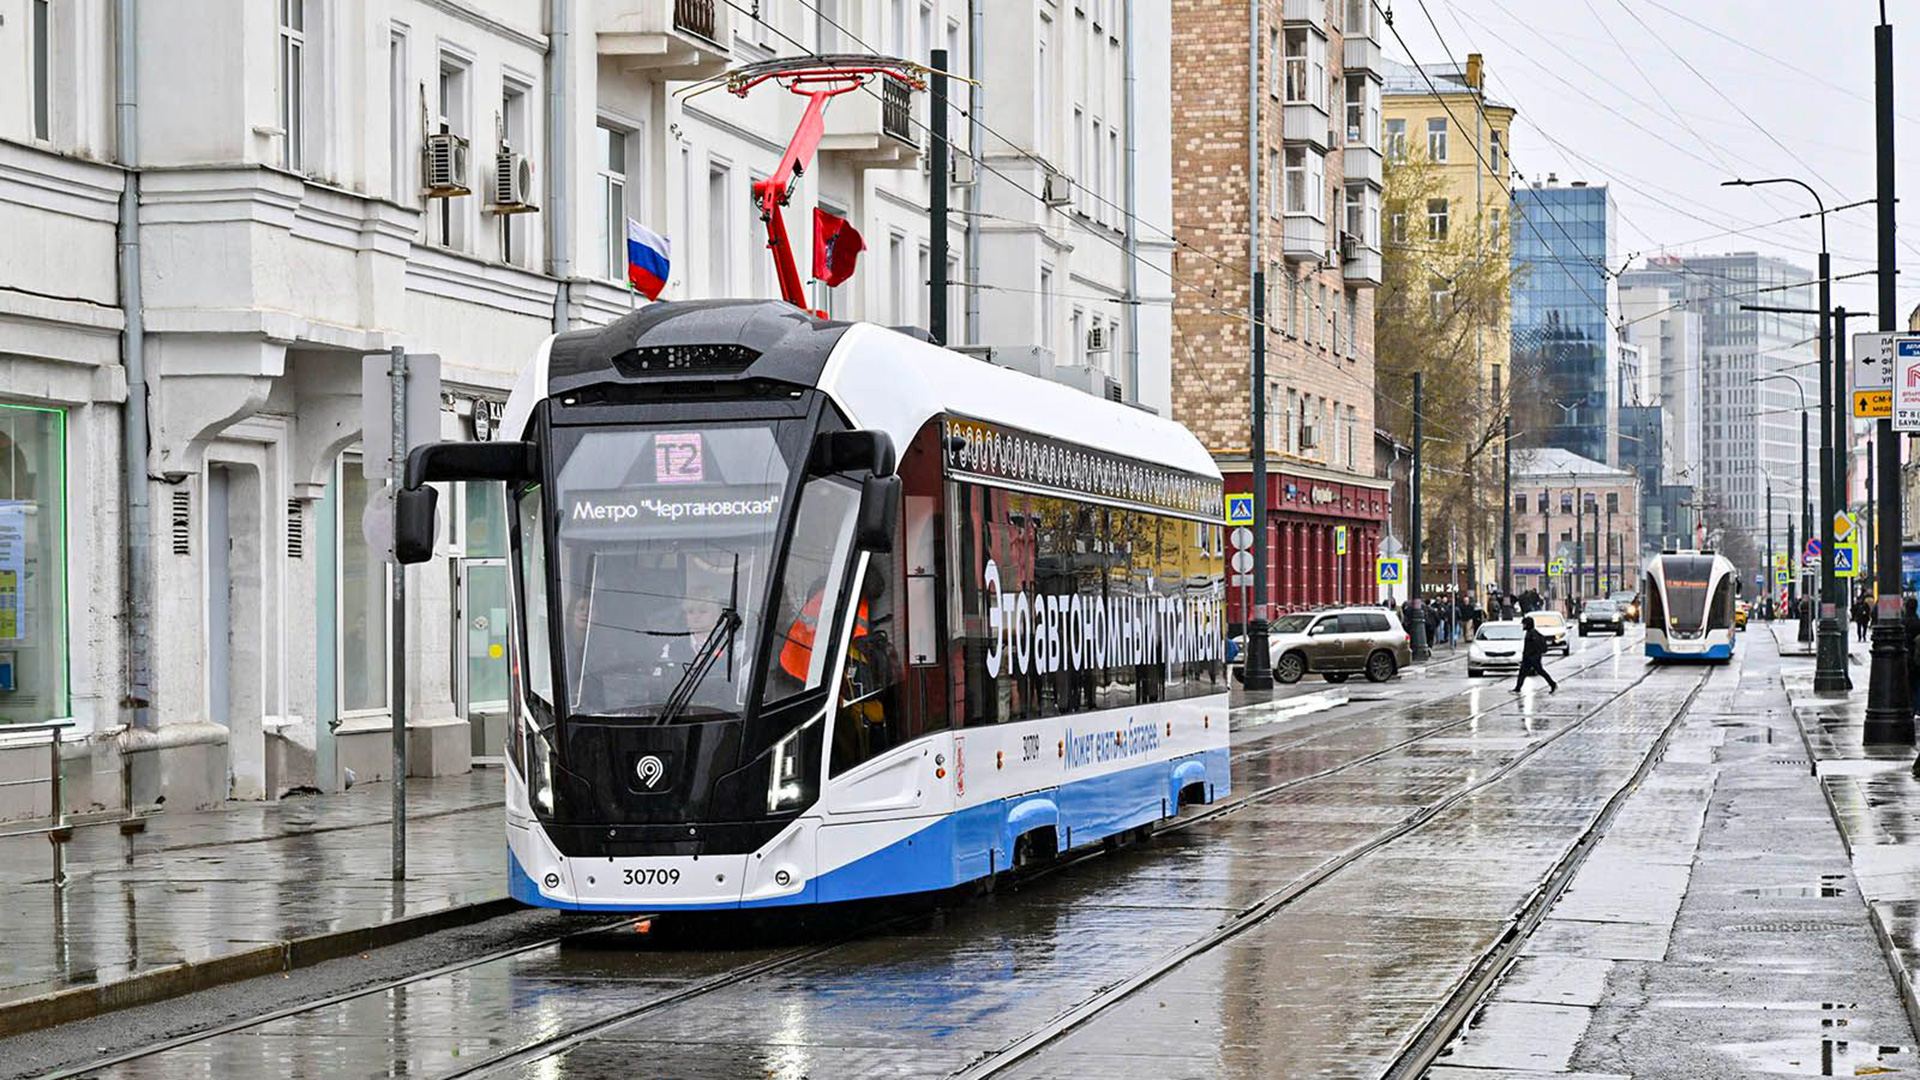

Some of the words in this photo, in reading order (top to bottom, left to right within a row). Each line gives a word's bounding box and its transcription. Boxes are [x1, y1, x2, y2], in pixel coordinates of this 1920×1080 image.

[657, 443, 700, 474] Т2
[573, 502, 637, 522] Метро
[641, 496, 778, 520] "Чертановская"
[984, 559, 1030, 678] Это
[1034, 576, 1157, 675] автономный
[1064, 728, 1094, 770] Может
[623, 869, 680, 885] 30709
